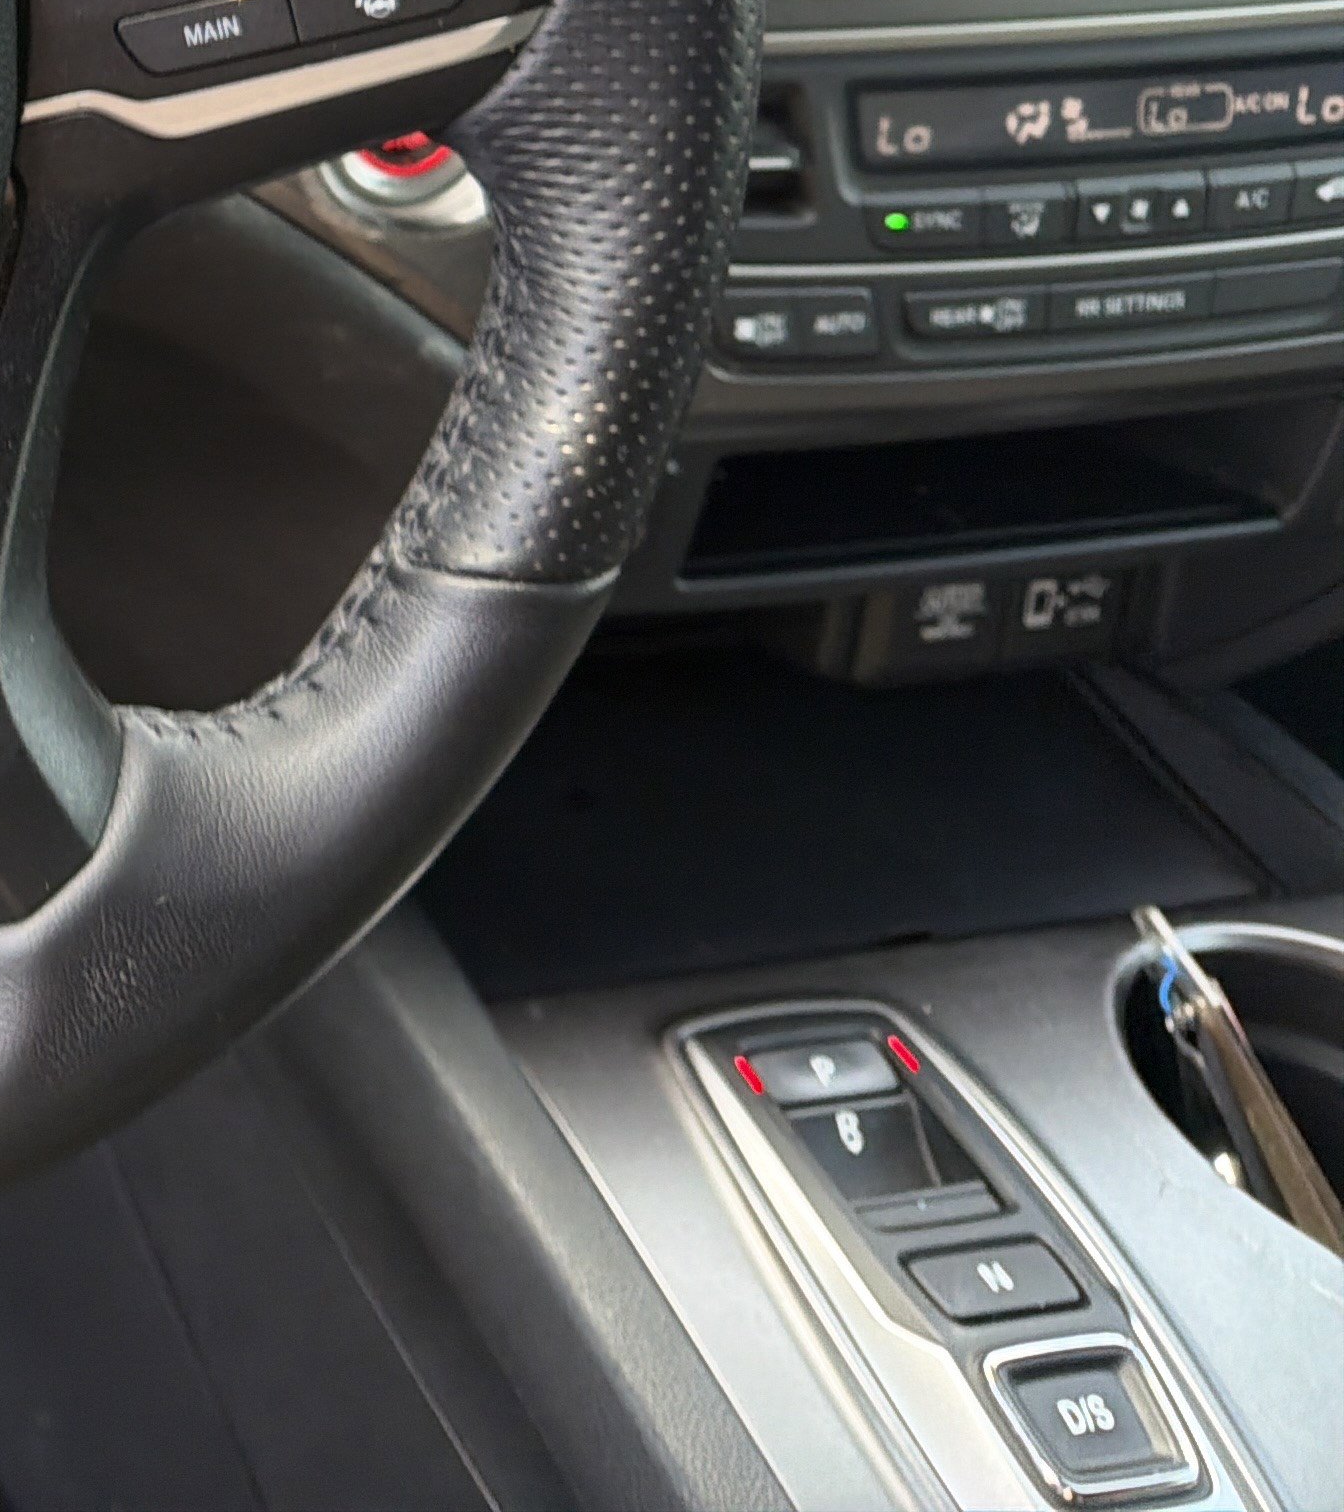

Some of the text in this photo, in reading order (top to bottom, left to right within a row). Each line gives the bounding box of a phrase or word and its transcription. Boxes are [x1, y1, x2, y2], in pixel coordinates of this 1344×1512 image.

[183, 15, 242, 49] MAIN
[1234, 187, 1270, 211] A/C
[808, 1053, 837, 1089] P
[976, 1260, 1015, 1294] N
